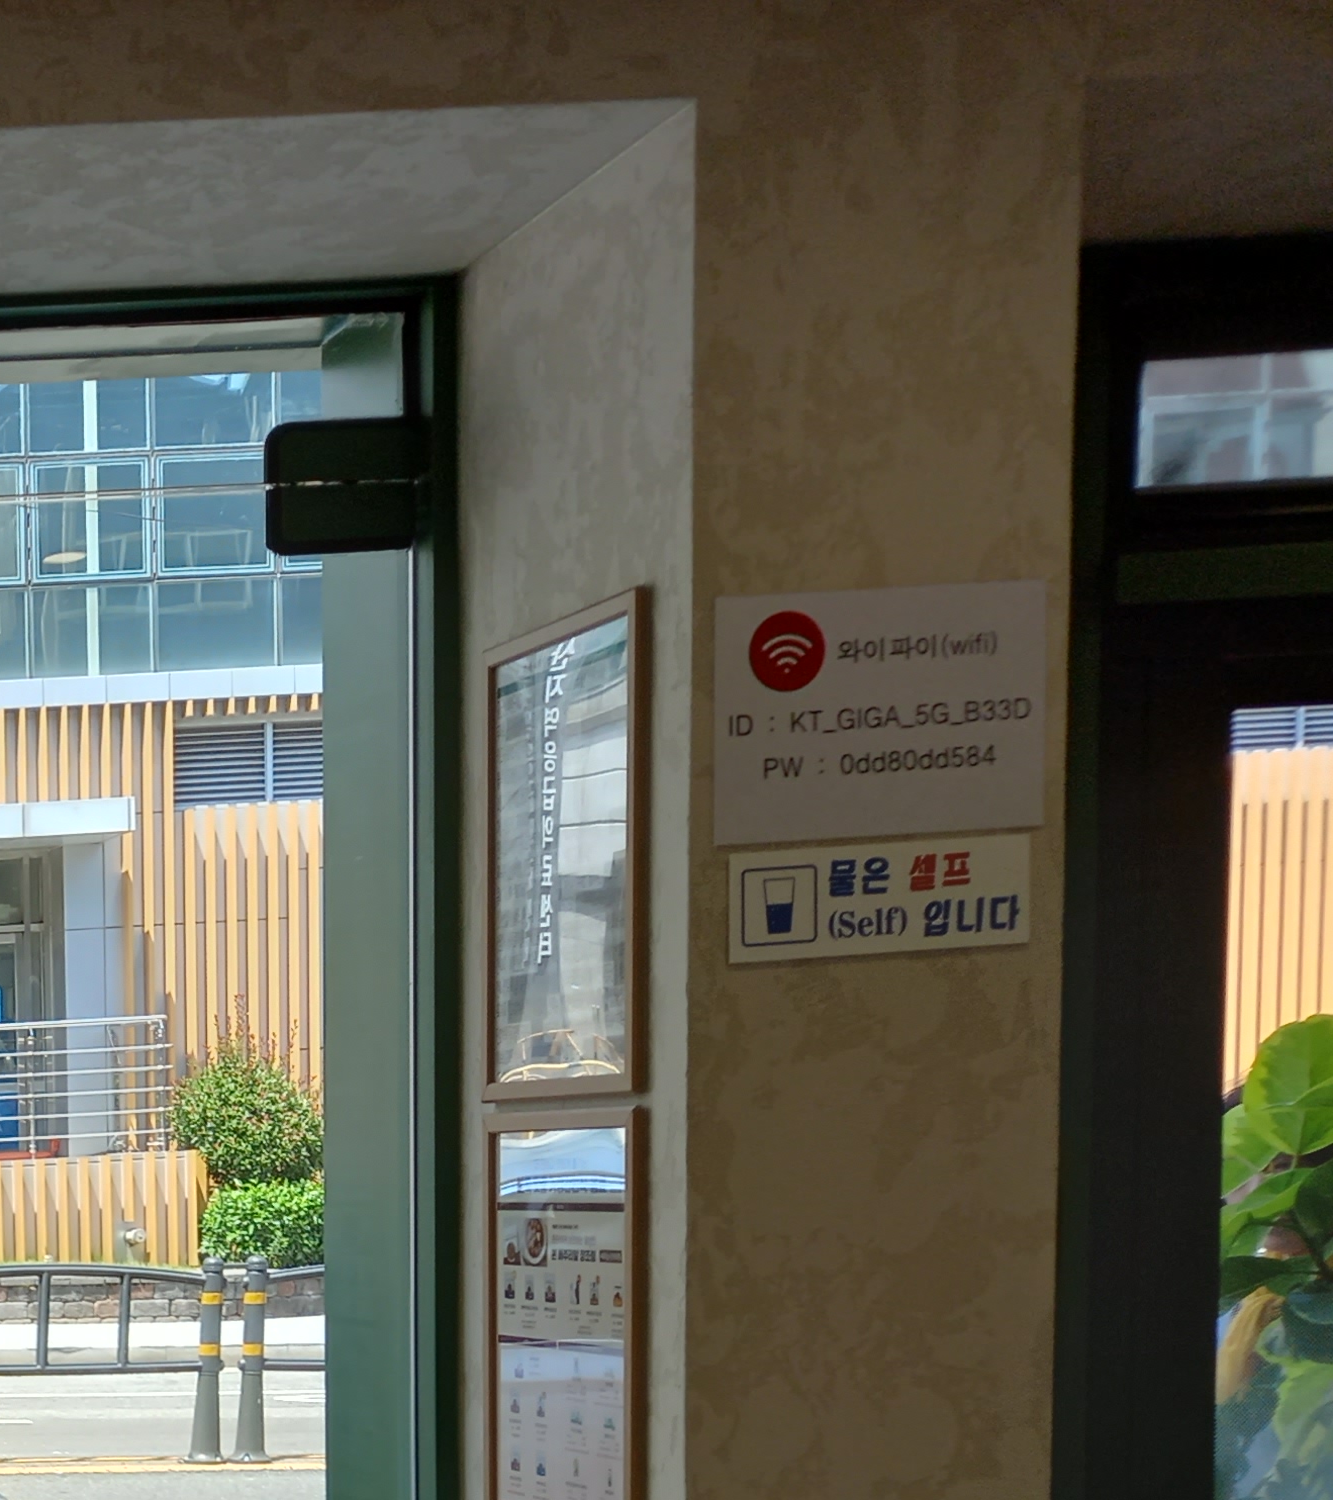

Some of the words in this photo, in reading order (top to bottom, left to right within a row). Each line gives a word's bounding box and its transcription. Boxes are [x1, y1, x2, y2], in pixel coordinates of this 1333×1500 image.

[838, 631, 999, 664] 와이파이(wifi)
[728, 714, 754, 738] ID
[789, 698, 1032, 735] KT_GIGA_5G_B33D
[763, 755, 804, 781] PW
[838, 744, 997, 776] 0dd80dd584
[828, 856, 891, 898] 물은
[908, 850, 972, 893] 셀프
[828, 907, 908, 941] (Self)
[924, 893, 1021, 938] 입니다
